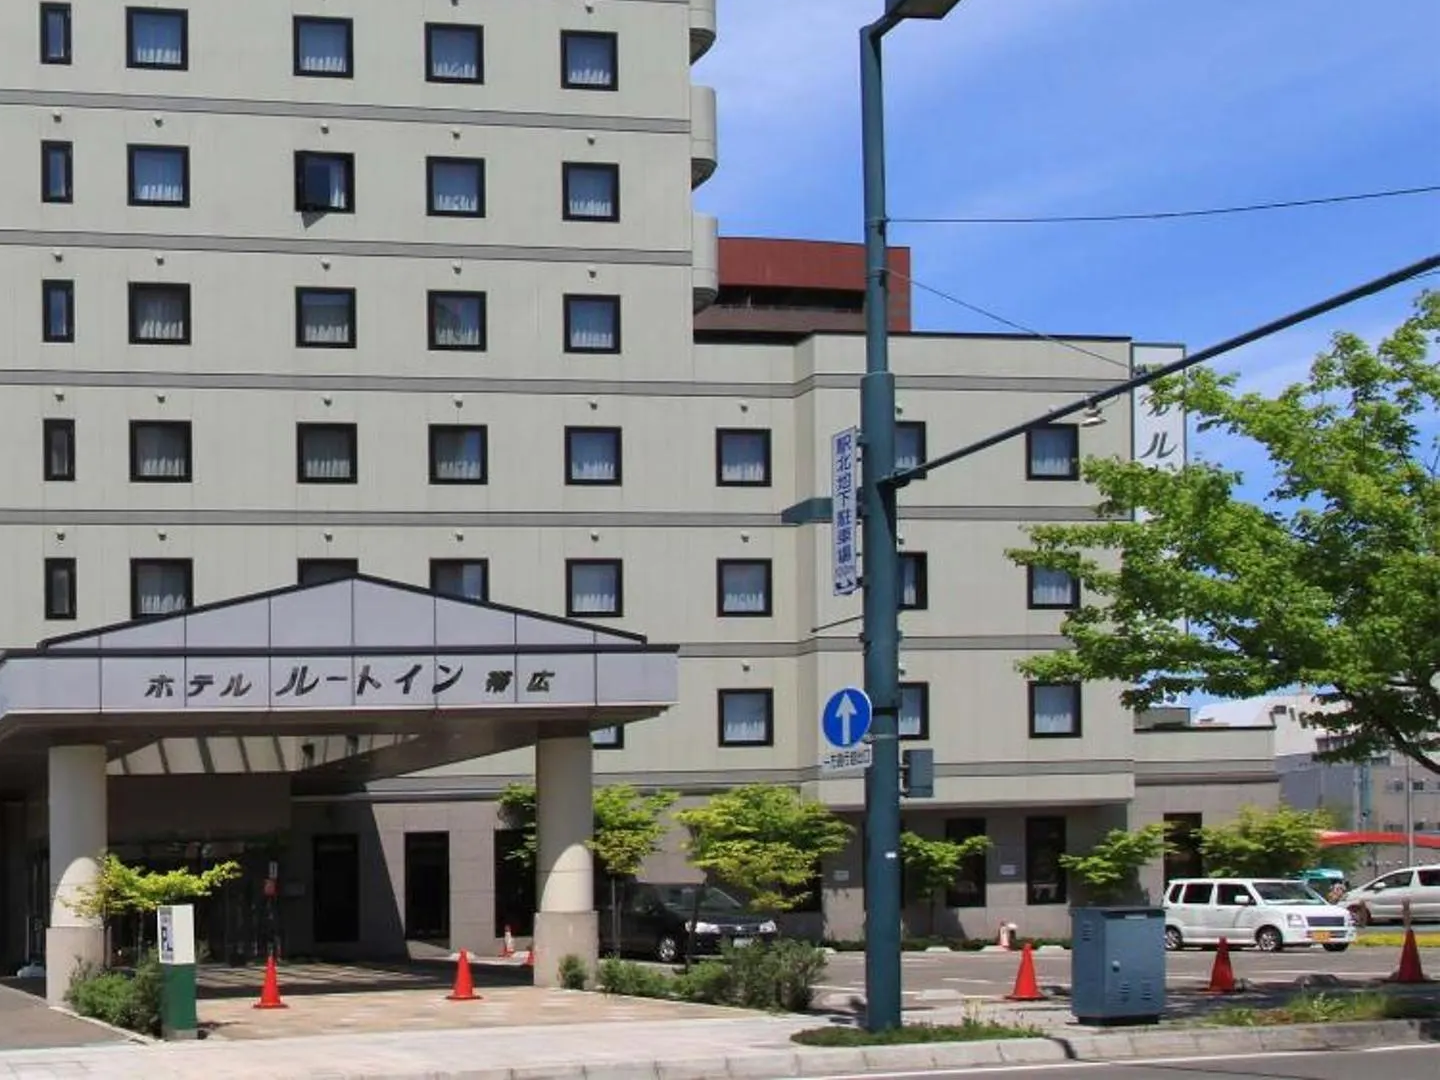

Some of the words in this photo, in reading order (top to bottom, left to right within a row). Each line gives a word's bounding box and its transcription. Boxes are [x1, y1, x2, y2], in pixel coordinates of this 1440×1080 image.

[144, 674, 252, 698] ホテル
[275, 664, 464, 697] ルートイン
[485, 670, 556, 695] 帯広
